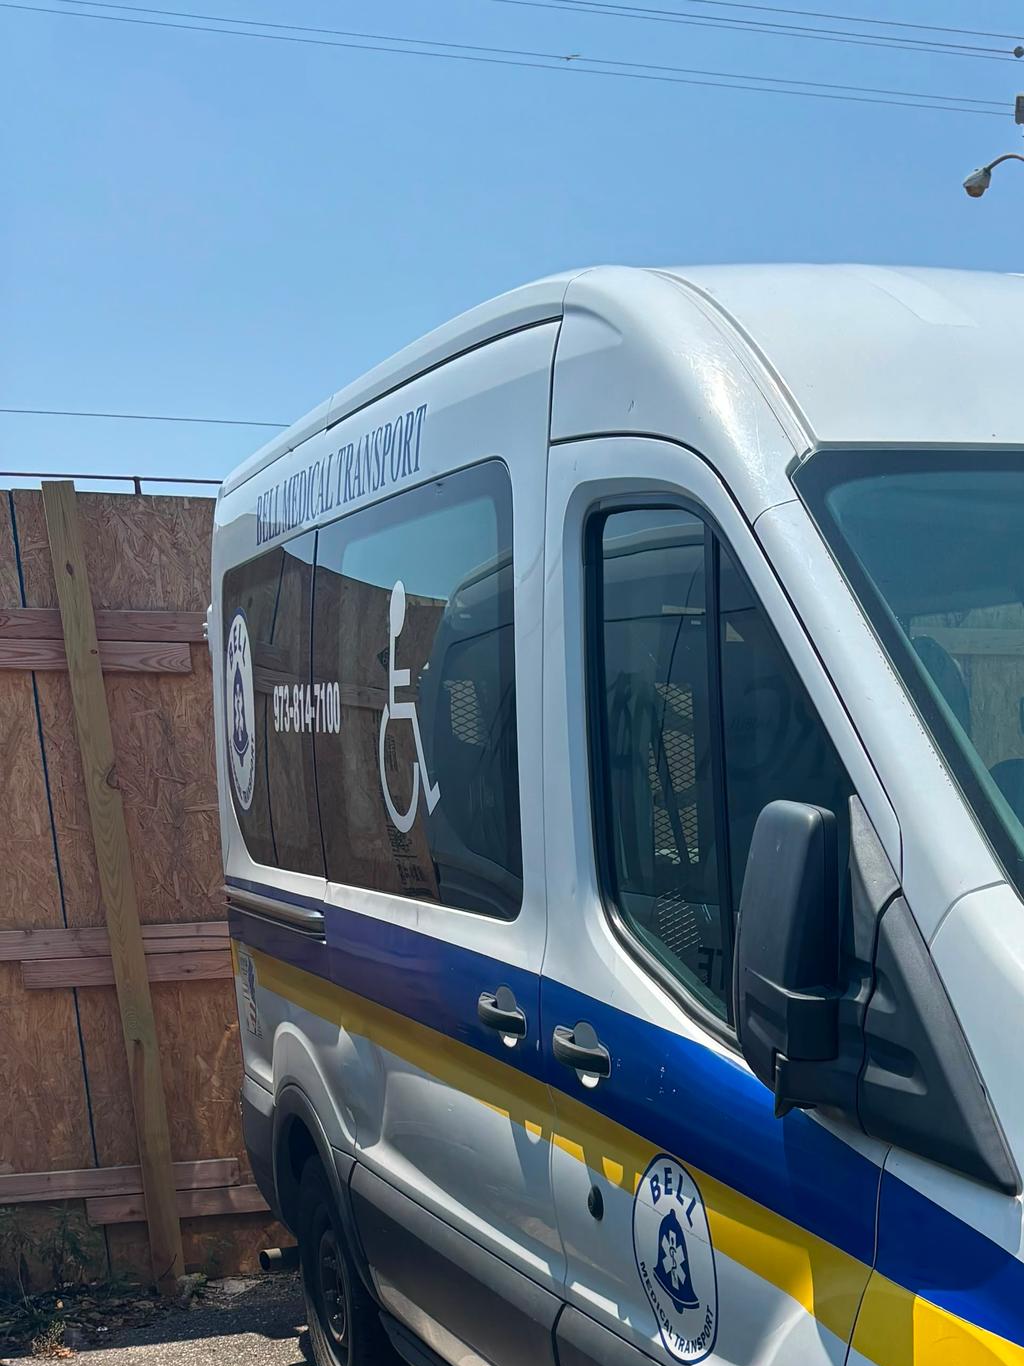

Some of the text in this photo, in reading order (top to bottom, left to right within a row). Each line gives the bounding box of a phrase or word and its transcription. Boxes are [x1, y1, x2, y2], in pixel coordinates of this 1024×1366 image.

[256, 404, 428, 546] BELL MEDICAL TRANSPORT
[273, 681, 341, 734] 973-814-7100
[649, 1166, 698, 1229] BELL
[639, 1260, 715, 1355] MEDICAL TRANSPORT
